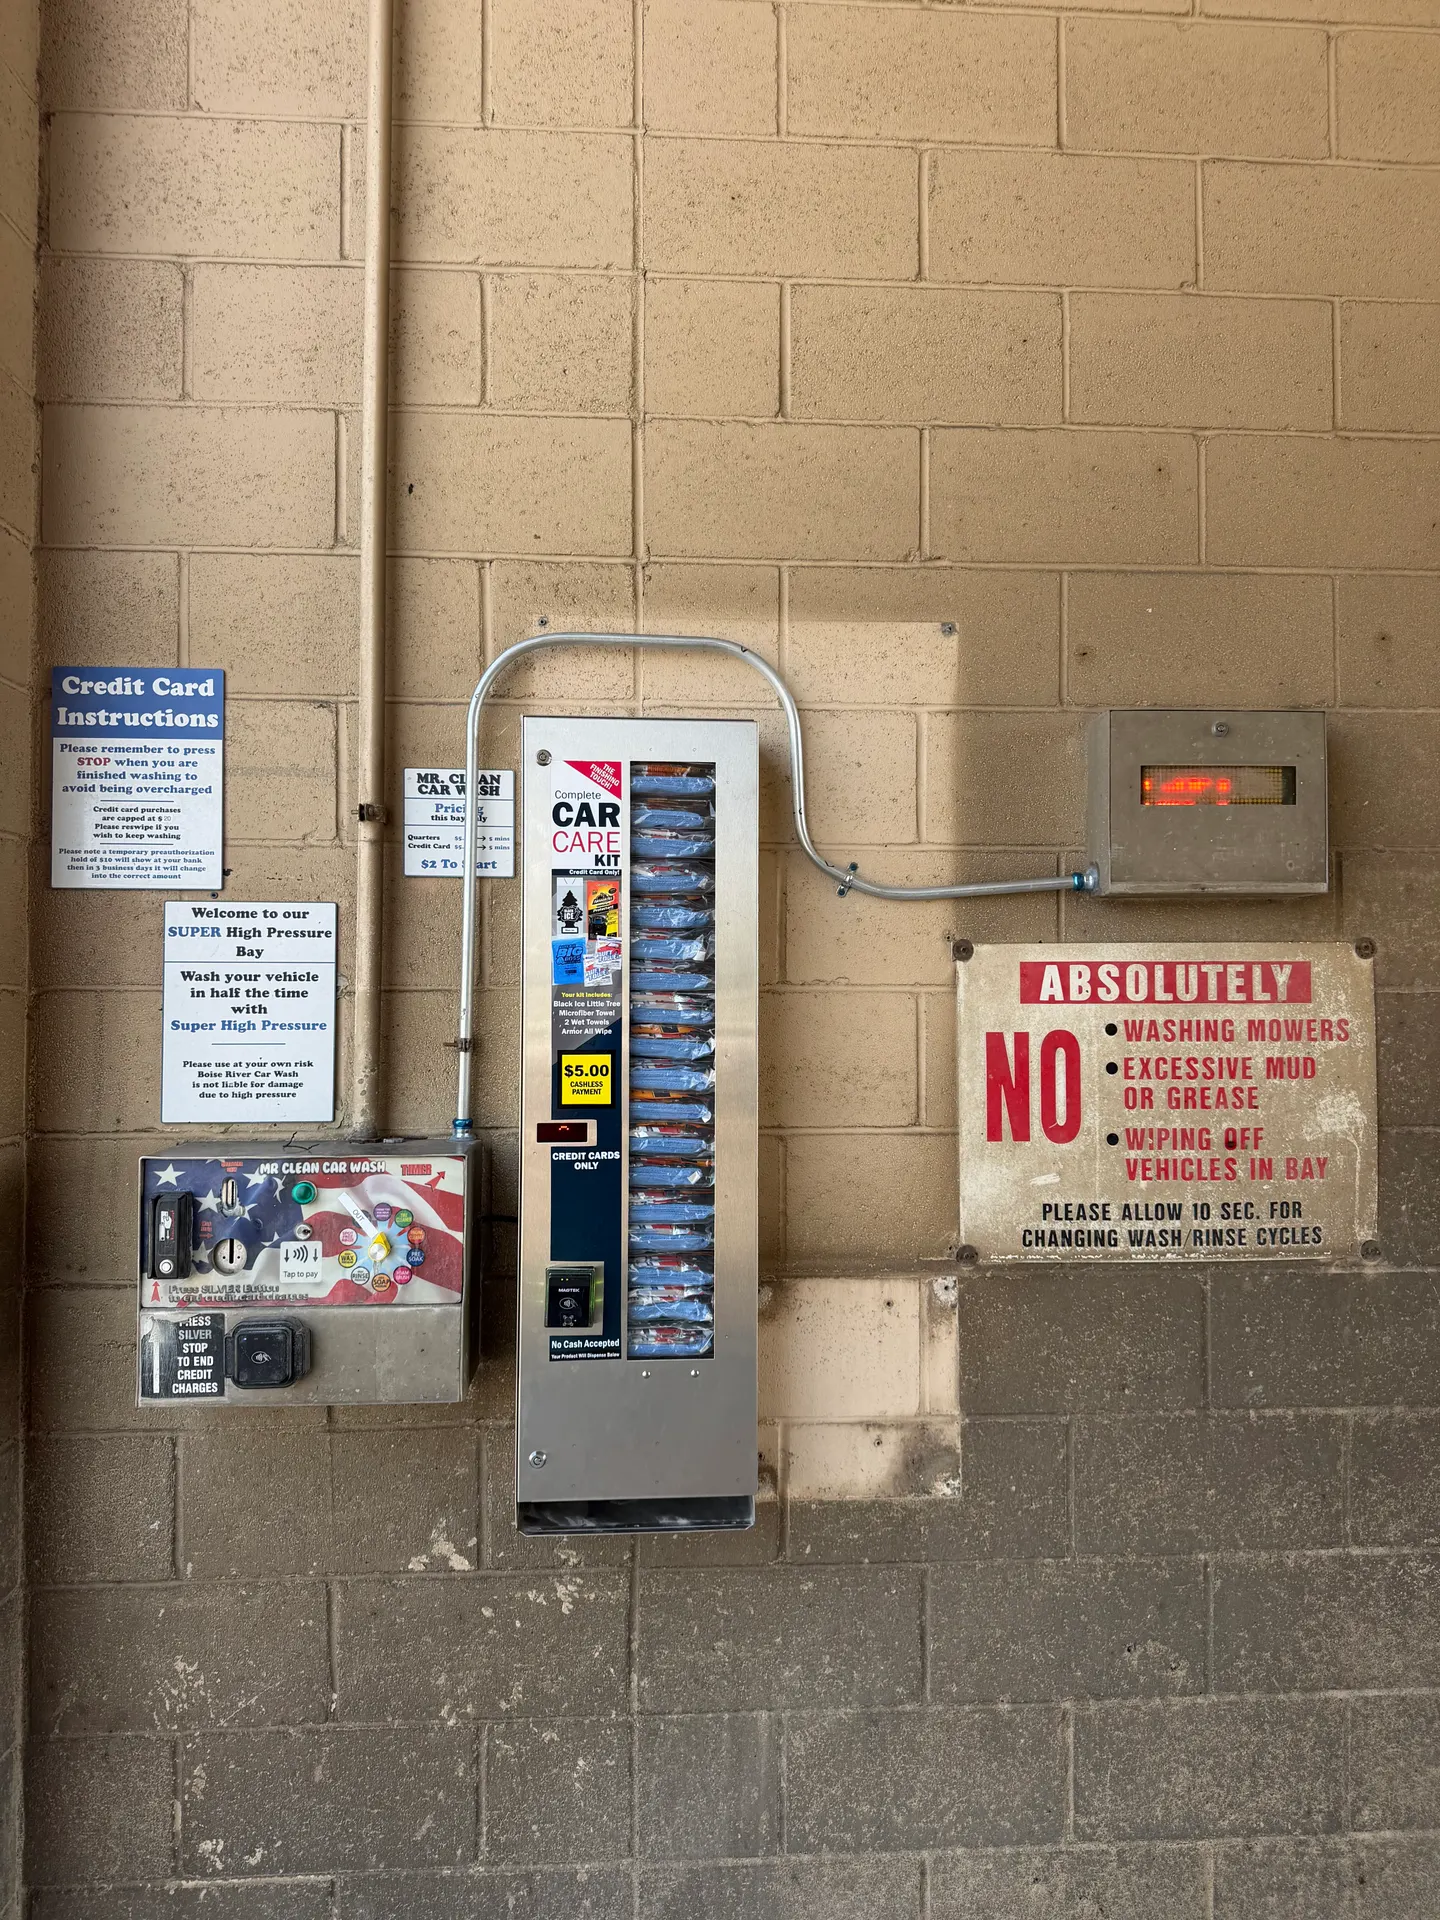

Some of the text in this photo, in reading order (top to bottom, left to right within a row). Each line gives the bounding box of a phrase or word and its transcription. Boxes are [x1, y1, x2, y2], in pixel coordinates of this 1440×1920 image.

[62, 676, 214, 696] Credit Card
[57, 707, 219, 728] Instructions
[60, 744, 215, 755] Please remember to press
[77, 758, 198, 769] STOP when you are
[603, 763, 615, 774] THE
[77, 771, 197, 782] finished washing to
[417, 773, 501, 785] MR. CLAN
[590, 764, 619, 786] FINISHING
[590, 772, 612, 790] TOUCH!
[62, 784, 212, 795] avoid being overcharged
[418, 785, 500, 796] CAR WSH
[555, 790, 601, 800] Complete
[552, 802, 620, 827] CAR
[121, 824, 154, 832] reswipe
[125, 832, 144, 840] keep
[553, 831, 620, 853] CARE
[421, 859, 437, 869] $2
[441, 859, 457, 868] To
[595, 855, 620, 866] KIT
[192, 907, 309, 919] Welcome to our
[168, 927, 332, 940] SUPER High Pressure
[236, 947, 264, 959] Bay
[181, 971, 319, 983] Wash your vehicle
[1040, 964, 1292, 1002] ABSOLUTELY
[190, 988, 309, 998] in half the time
[231, 1004, 268, 1014] with
[171, 1021, 327, 1033] Super High Pressure
[1124, 1019, 1350, 1042] WASHING MOWERS
[245, 1061, 268, 1069] your
[1123, 1057, 1316, 1080] EXCESSIVE MUD
[564, 1065, 609, 1078] $5.00
[268, 1081, 304, 1090] damage
[986, 1030, 1081, 1144] NO
[231, 1091, 253, 1099] high
[1124, 1086, 1259, 1110] OR GREASE
[1125, 1127, 1263, 1150] WIPING OFF
[552, 1151, 620, 1160] CREDIT CARDS
[260, 1161, 386, 1174] MR CLEAN CAR WASH
[401, 1164, 432, 1175] TIMER
[574, 1162, 598, 1170] ONLY
[1126, 1157, 1328, 1181] VEHICLES IN BAY
[353, 1209, 365, 1223] OUT
[1042, 1201, 1302, 1221] PLEASE ALLOW 10 SEC. FOR
[1022, 1229, 1118, 1248] CHANGING
[1256, 1227, 1322, 1245] CYCLES
[284, 1271, 295, 1279] Tap
[179, 1316, 211, 1326] ESS
[179, 1330, 212, 1340] SILVER
[183, 1343, 208, 1353] STOP
[564, 1340, 582, 1348] Cash
[584, 1339, 619, 1348] Accepted
[177, 1356, 213, 1367] TO END
[178, 1369, 212, 1380] CREDIT
[172, 1383, 218, 1393] CHARGES
